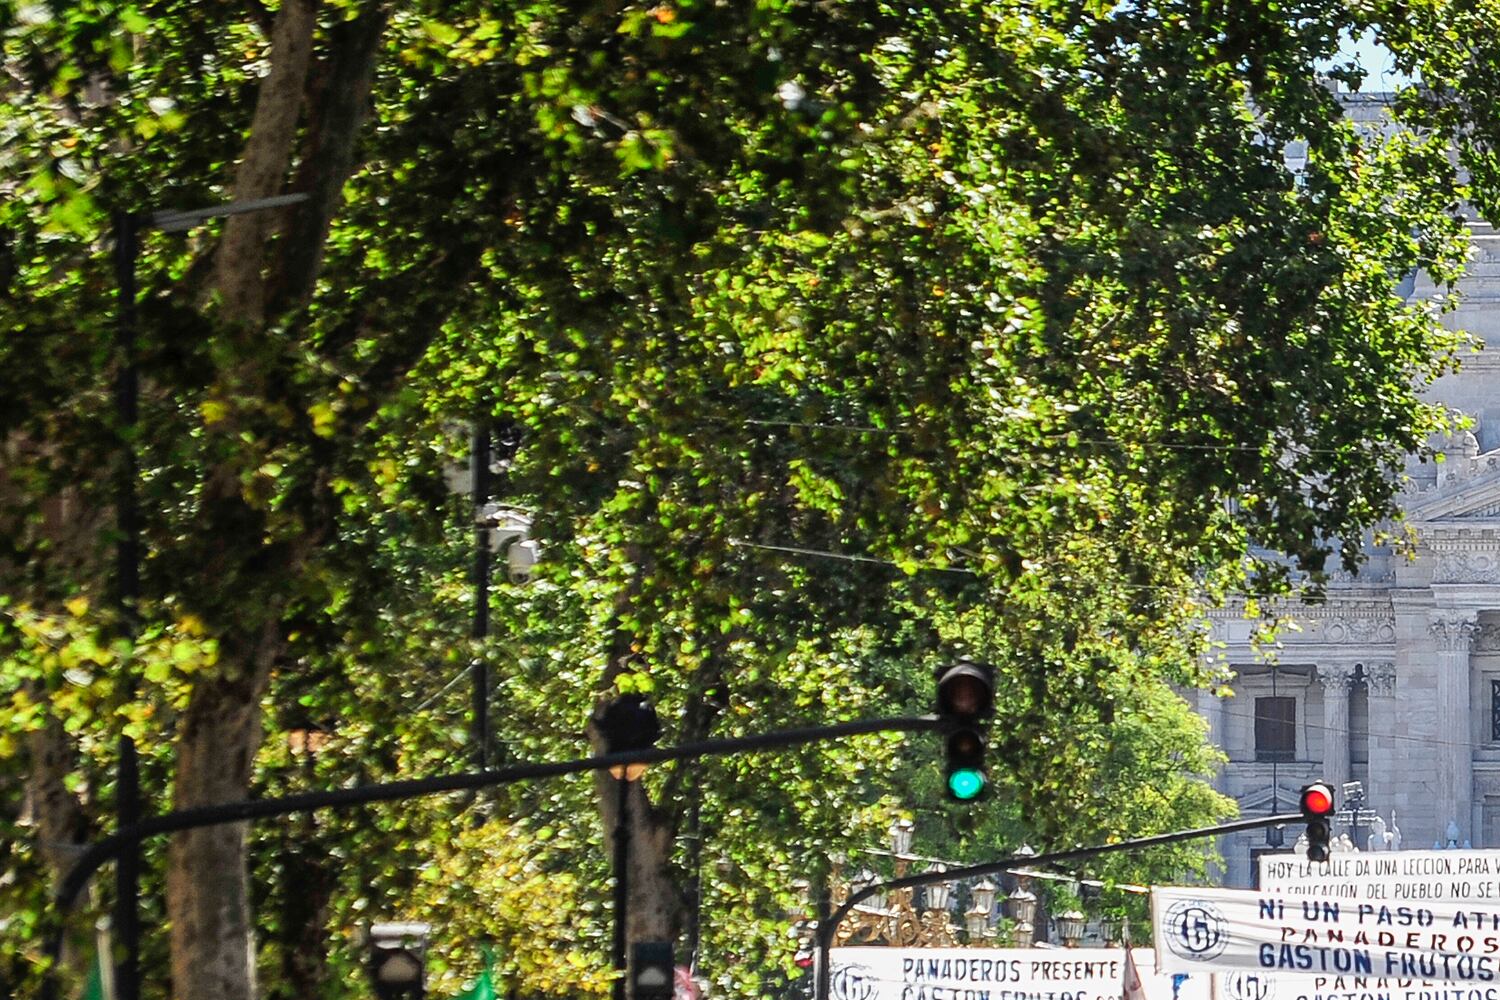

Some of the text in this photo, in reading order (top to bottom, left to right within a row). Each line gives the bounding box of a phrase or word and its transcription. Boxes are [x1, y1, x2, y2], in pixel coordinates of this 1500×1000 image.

[1268, 861, 1294, 879] HOY
[1299, 862, 1312, 878] LA
[1318, 859, 1350, 878] CALLE
[1355, 860, 1370, 877] DA
[1375, 858, 1398, 876] UNA
[1458, 858, 1490, 875] PARA
[1366, 883, 1388, 899] DEL
[1394, 881, 1443, 899] PUEBLO
[1451, 881, 1471, 898] NO
[1477, 881, 1492, 898] SE
[1302, 900, 1340, 922] UN
[1358, 903, 1434, 927] PASO
[1280, 926, 1499, 954] PANADEROS
[903, 957, 1118, 983] PANADEROS PRESENTE
[1259, 942, 1373, 975] GASTON
[1386, 951, 1494, 982] FRUTOS
